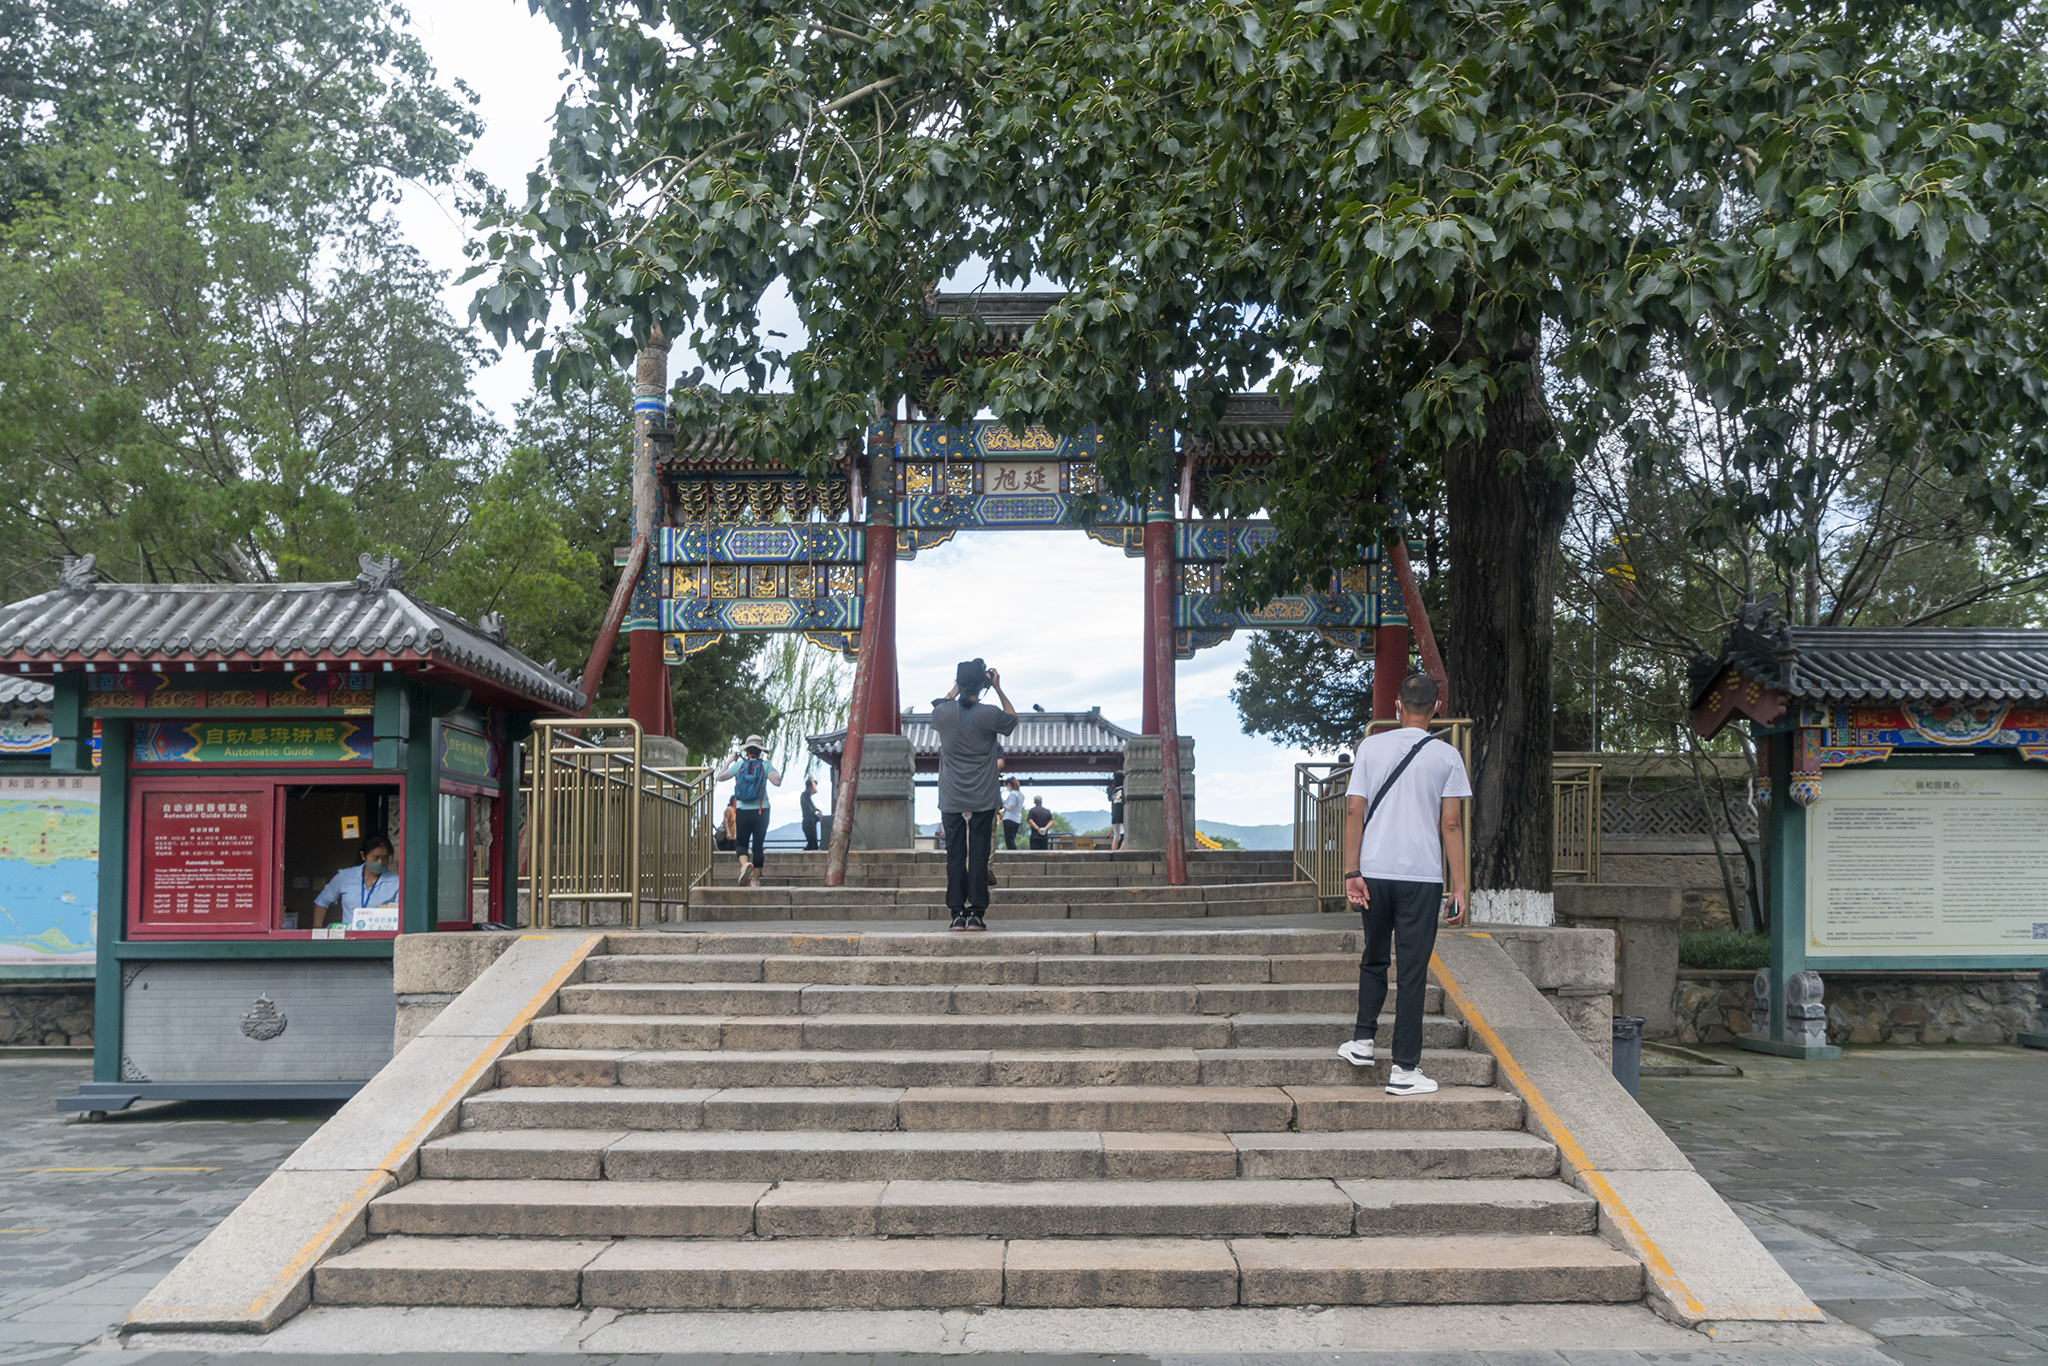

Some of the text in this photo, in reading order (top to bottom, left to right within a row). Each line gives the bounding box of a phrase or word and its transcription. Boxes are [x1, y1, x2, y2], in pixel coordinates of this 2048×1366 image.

[206, 727, 336, 745] 自动导游讲解
[223, 746, 314, 757] Automatic Guide
[0, 778, 82, 789] 和园全景图
[163, 804, 247, 812] 自动讲解器领取处
